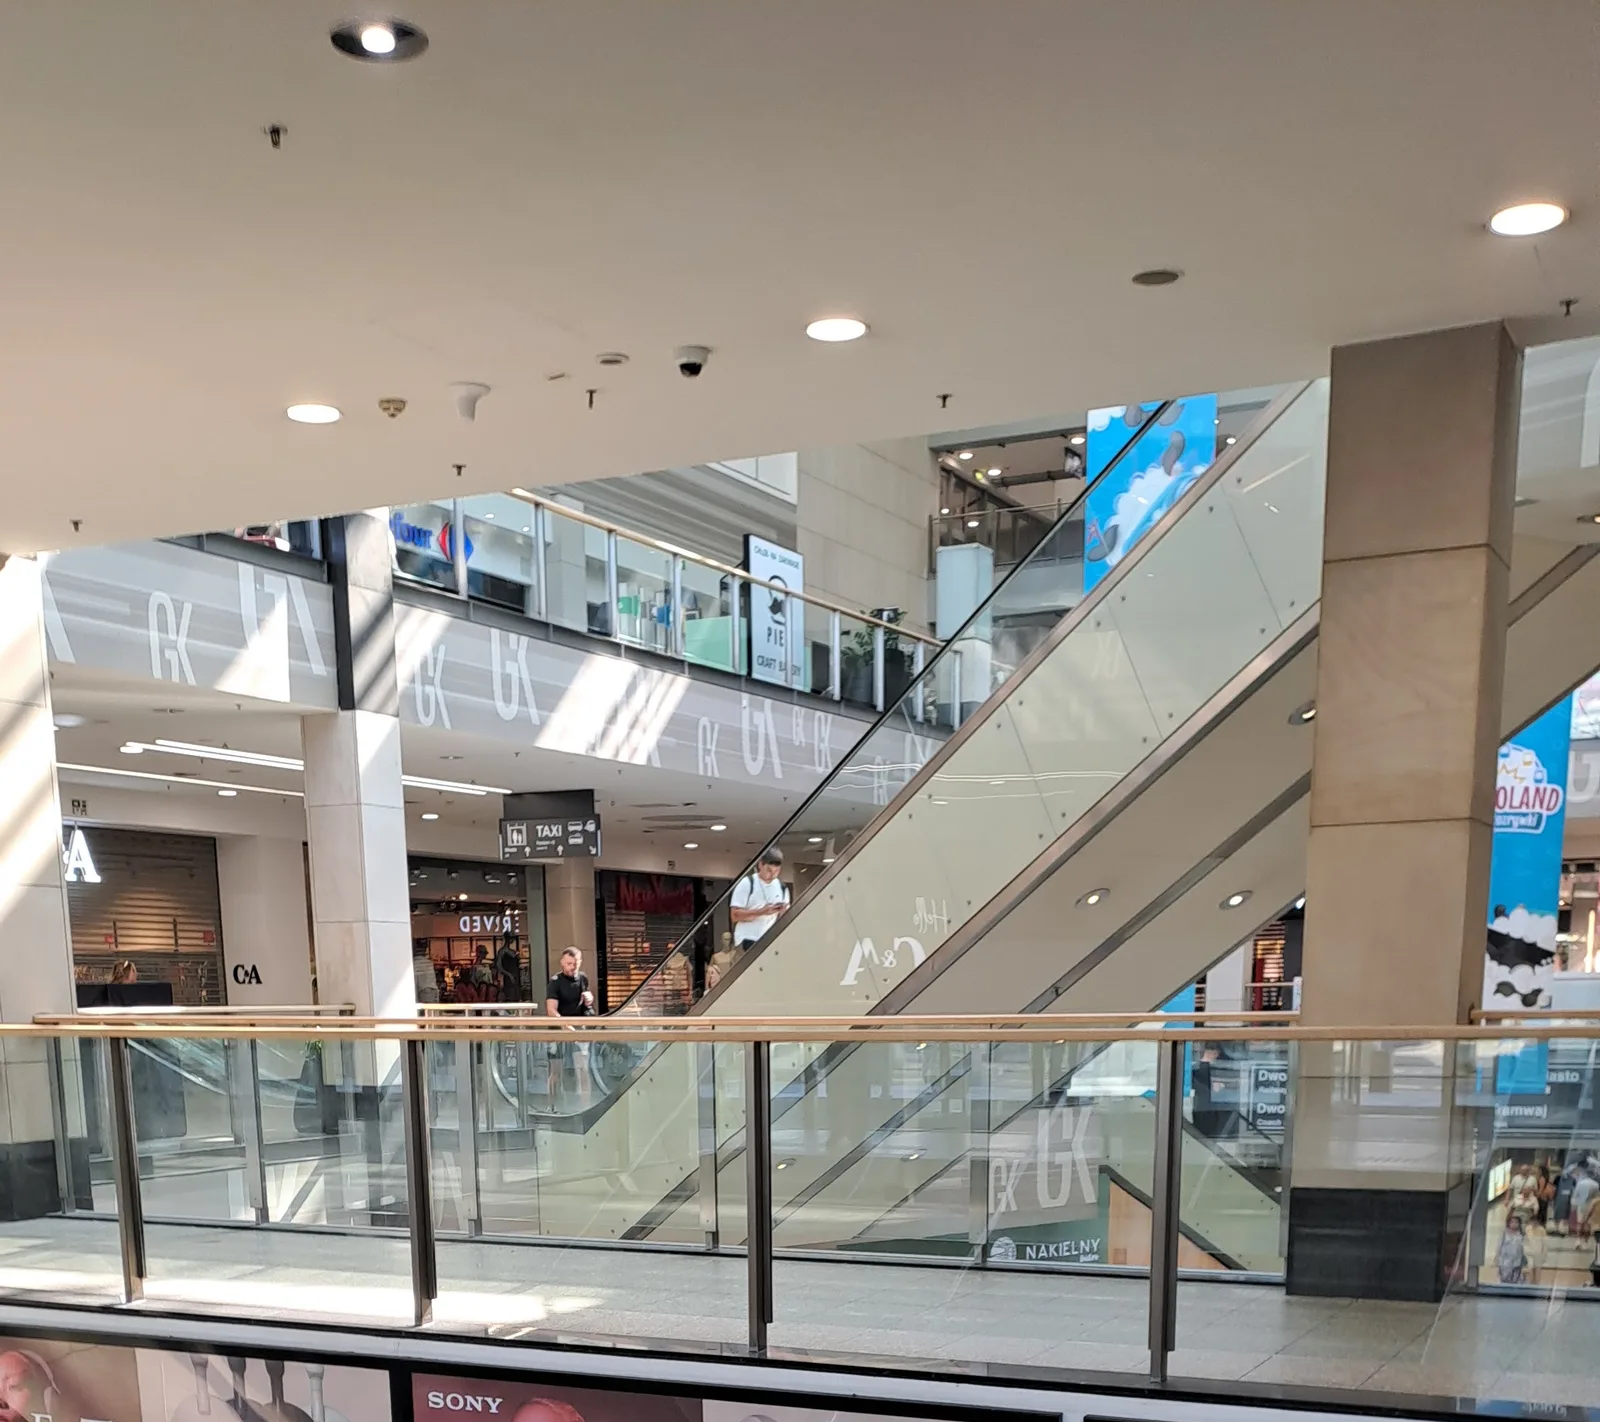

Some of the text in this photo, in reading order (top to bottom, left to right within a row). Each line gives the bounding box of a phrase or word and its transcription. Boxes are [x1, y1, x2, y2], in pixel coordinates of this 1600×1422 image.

[389, 512, 432, 549] four
[536, 824, 562, 838] TAXI
[1258, 1070, 1287, 1082] Dwo
[1546, 1070, 1580, 1083] iasto
[1257, 1103, 1285, 1114] Dwo
[1026, 1237, 1101, 1260] NAKIELNY
[428, 1391, 503, 1413] SONY
